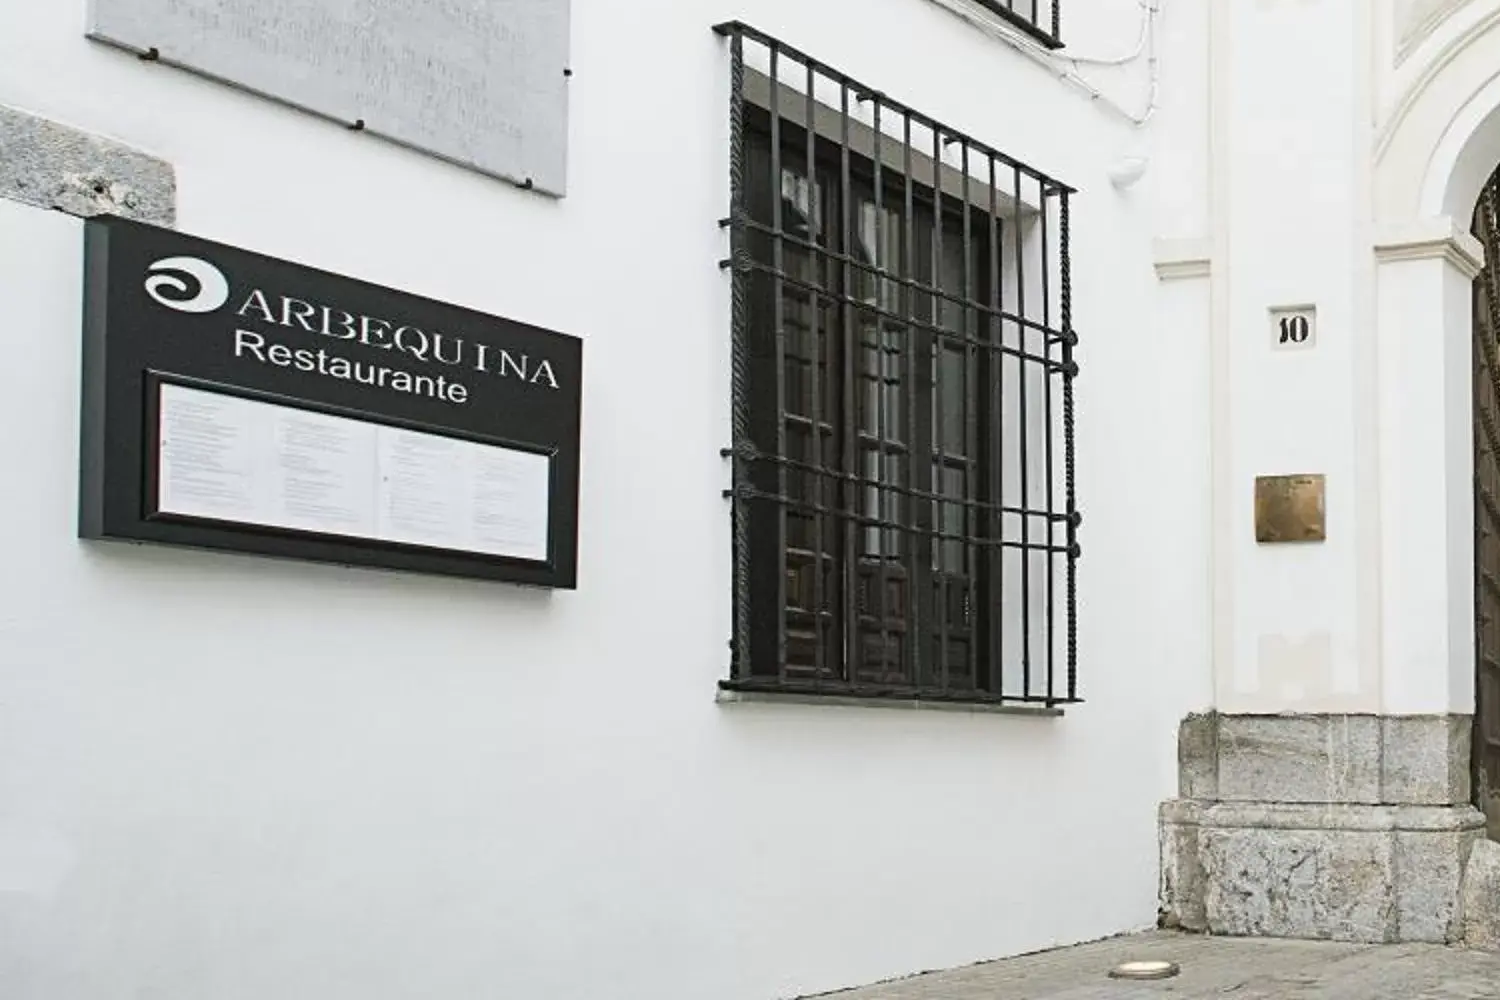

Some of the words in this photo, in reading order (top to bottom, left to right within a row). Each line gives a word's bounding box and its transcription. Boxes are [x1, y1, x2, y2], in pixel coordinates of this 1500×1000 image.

[234, 328, 469, 404] Restaurante
[237, 288, 560, 390] ARBEQUINA
[1279, 314, 1310, 345] 10
